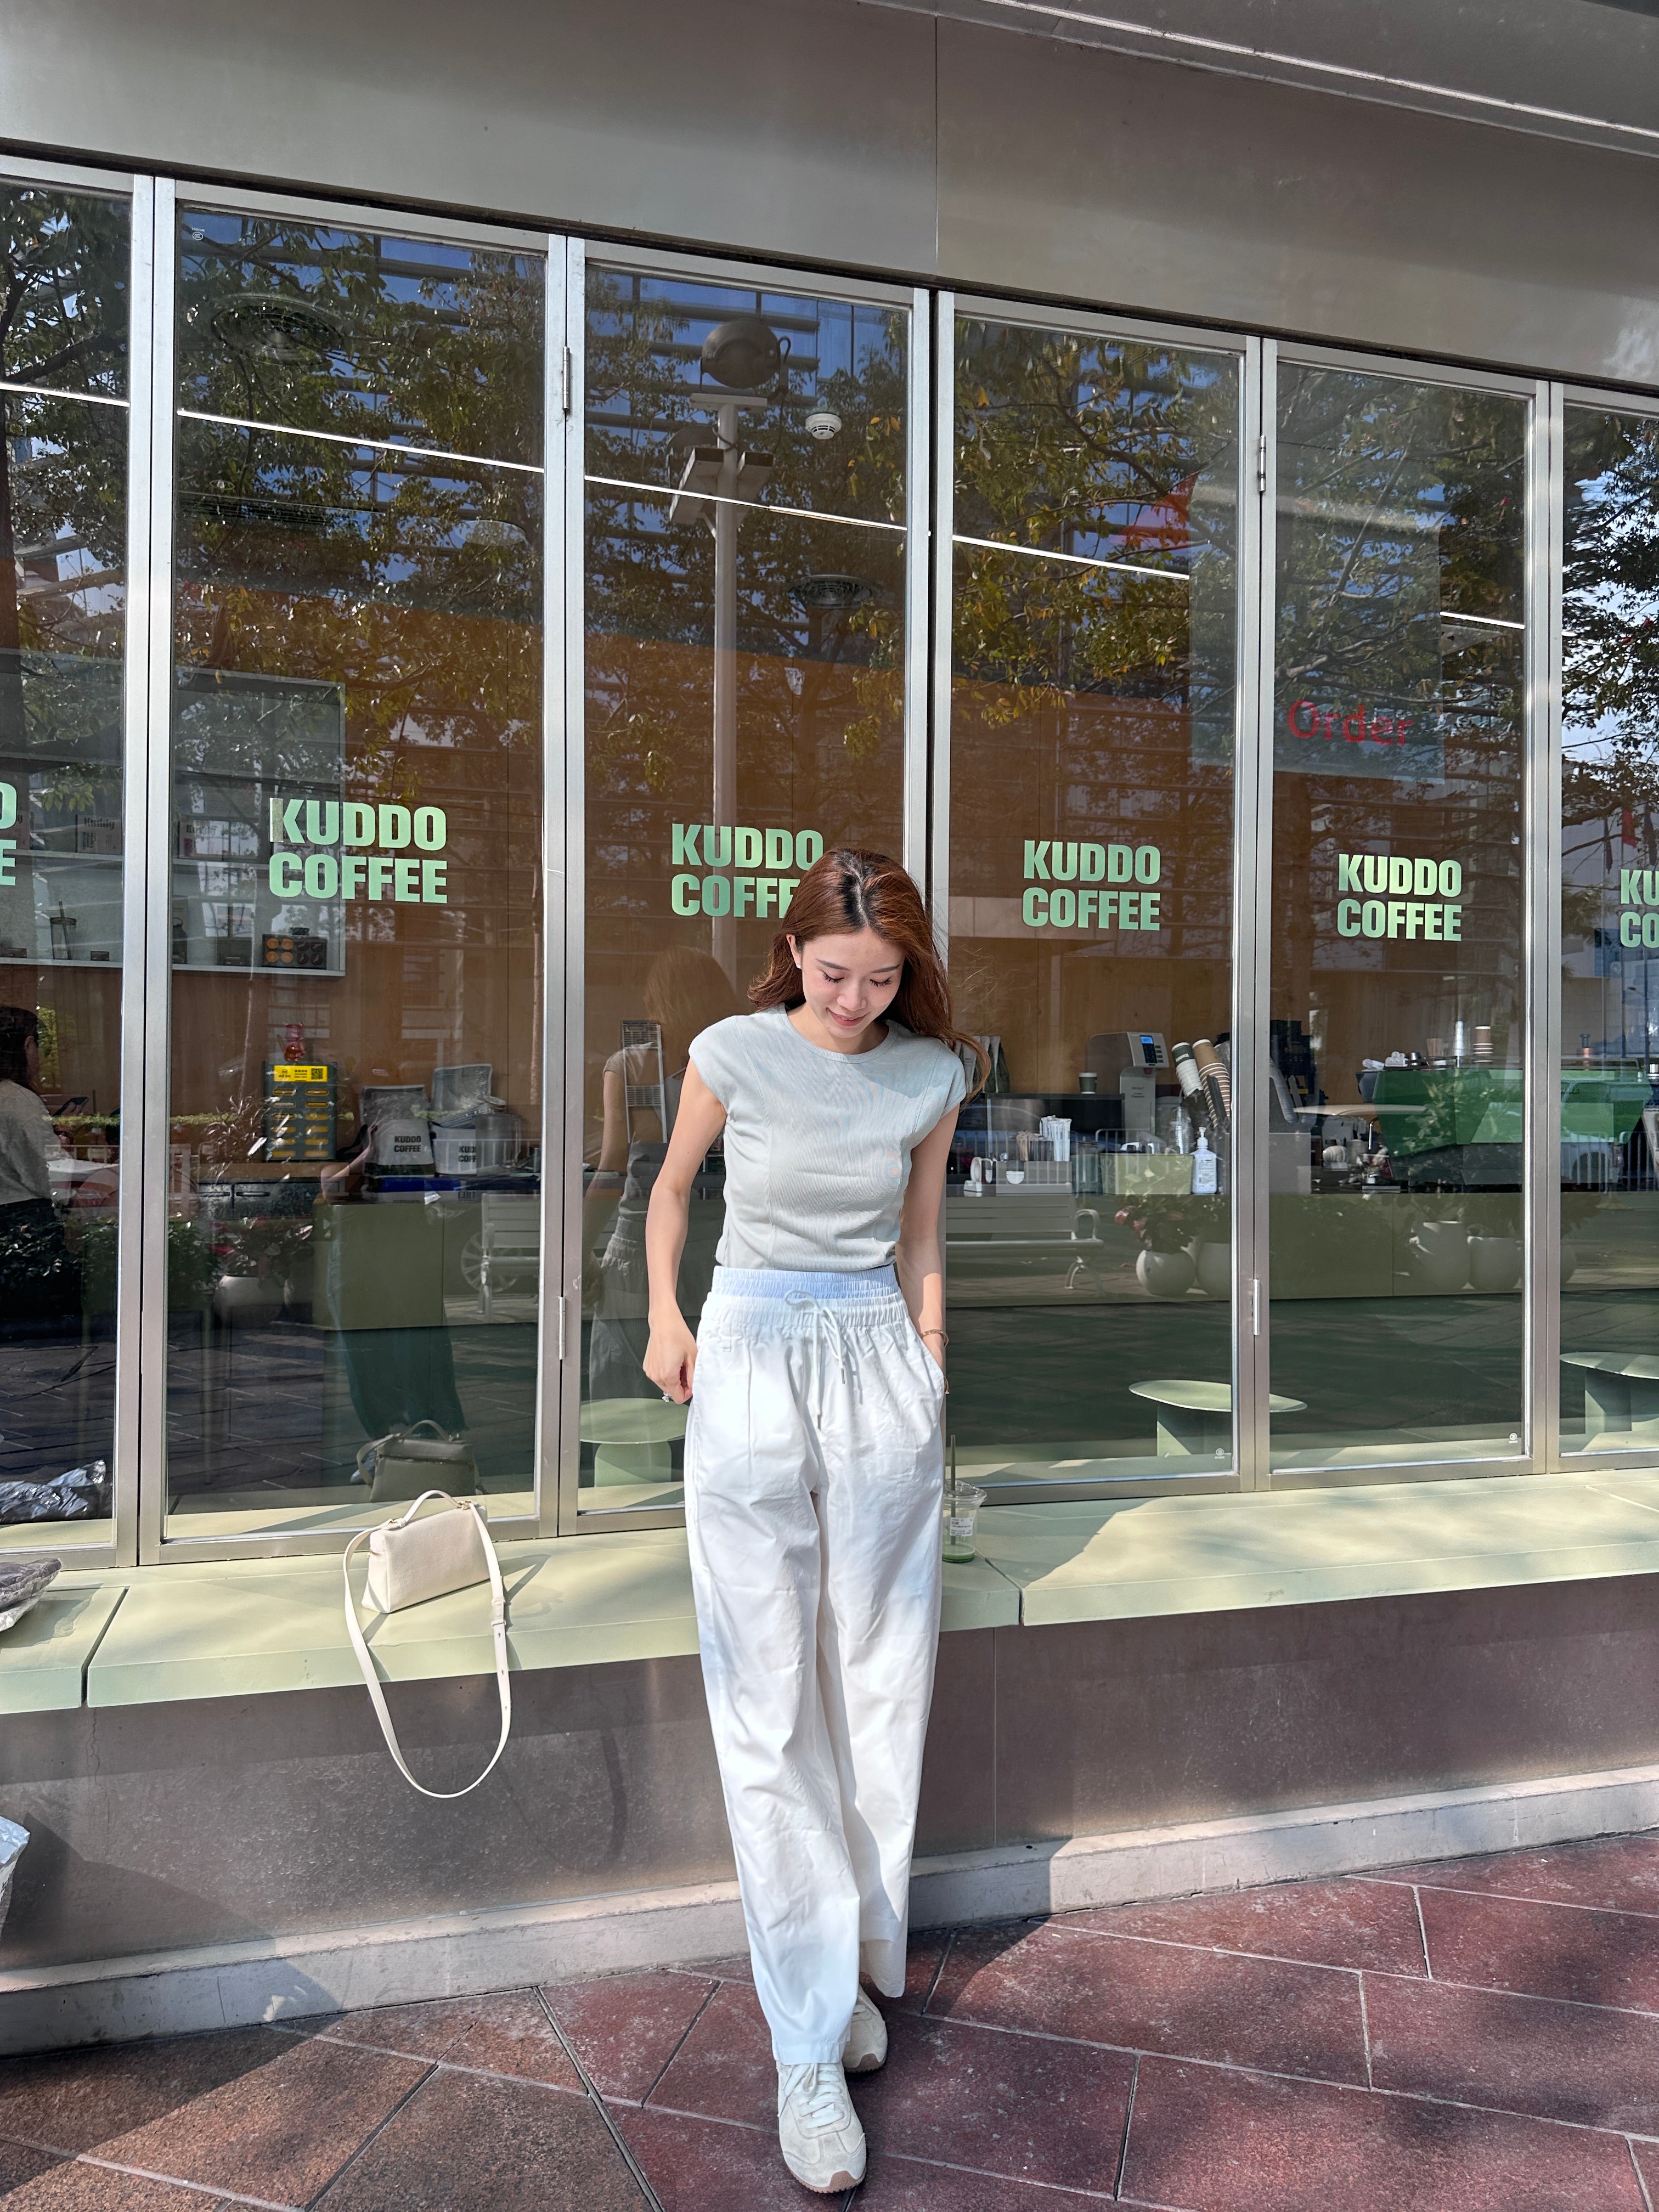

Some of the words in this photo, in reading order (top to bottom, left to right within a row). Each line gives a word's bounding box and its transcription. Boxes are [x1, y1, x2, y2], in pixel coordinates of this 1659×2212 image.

[1288, 700, 1414, 746] Order
[269, 797, 447, 851] KUDDO
[672, 823, 823, 871] KUDDO
[1024, 839, 1161, 884] KUDDO
[269, 851, 448, 904] COFFEE
[672, 873, 801, 918] COFFE
[1338, 853, 1462, 898] KUDDO
[1023, 887, 1160, 931] COFFEE
[1337, 899, 1462, 941] COFFEE
